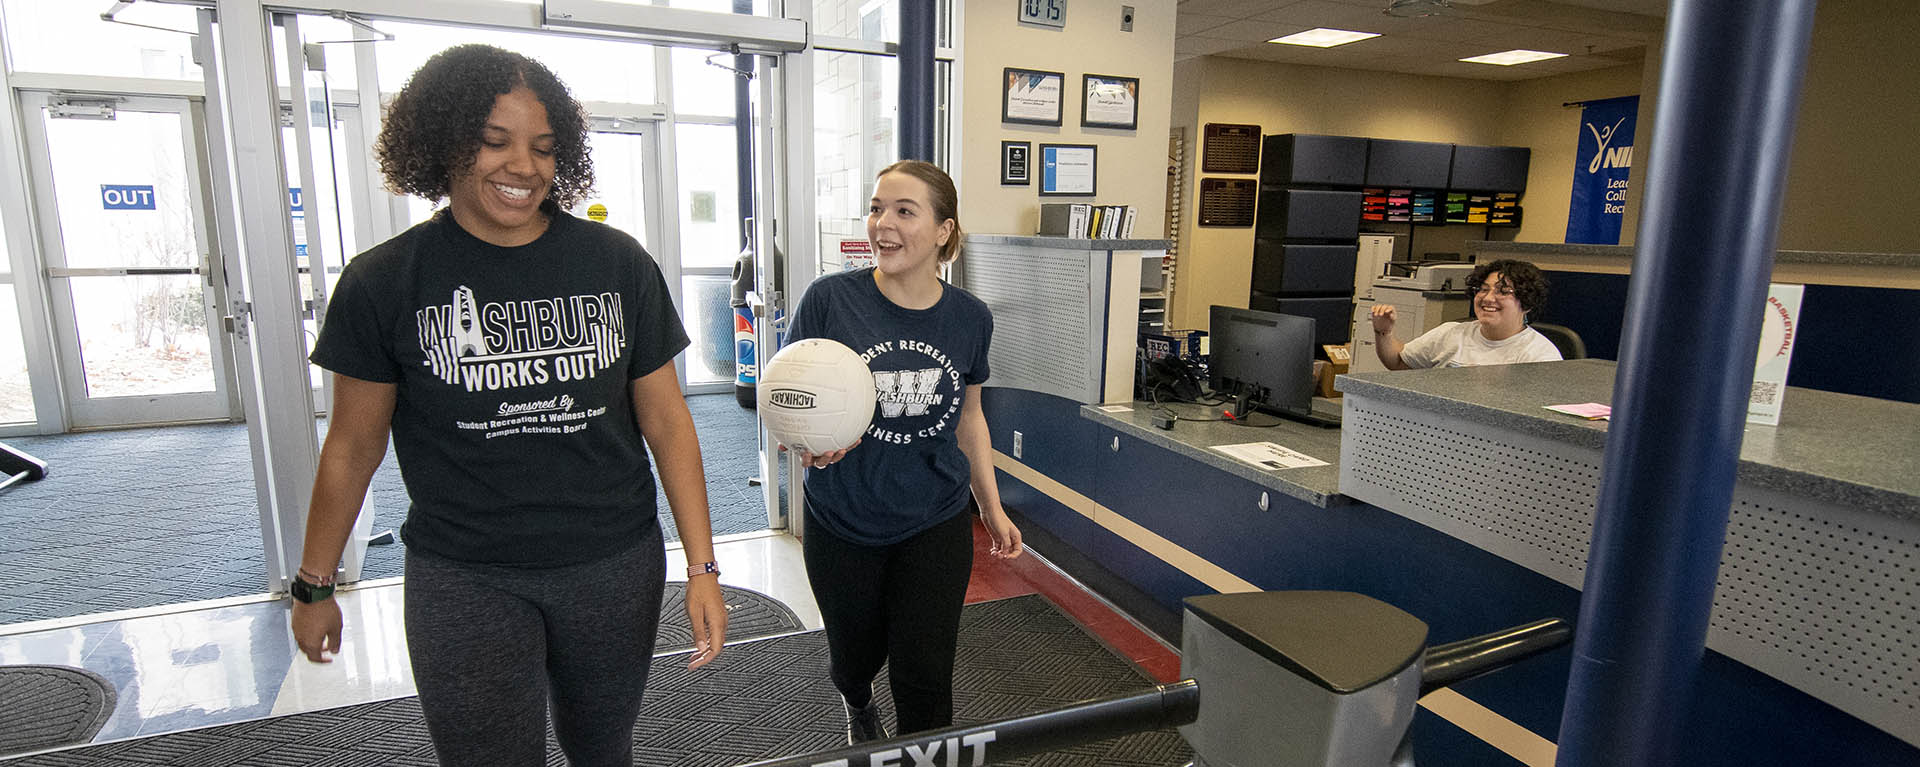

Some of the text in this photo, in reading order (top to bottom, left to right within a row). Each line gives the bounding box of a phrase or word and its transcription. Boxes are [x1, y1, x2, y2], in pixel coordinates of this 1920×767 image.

[103, 188, 152, 207] OUT
[417, 285, 625, 357] WASHBURN
[460, 353, 596, 392] WORKS OUT
[863, 339, 960, 392] DENT RECREATION
[496, 394, 575, 416] Sponsored By
[771, 391, 815, 409] TACHIKARA
[457, 419, 488, 430] Student
[490, 415, 538, 428] Recreation
[540, 414, 547, 423] &
[548, 410, 586, 422] Wellness
[919, 397, 961, 438] CENTER
[486, 422, 587, 440] Campus Activities Board
